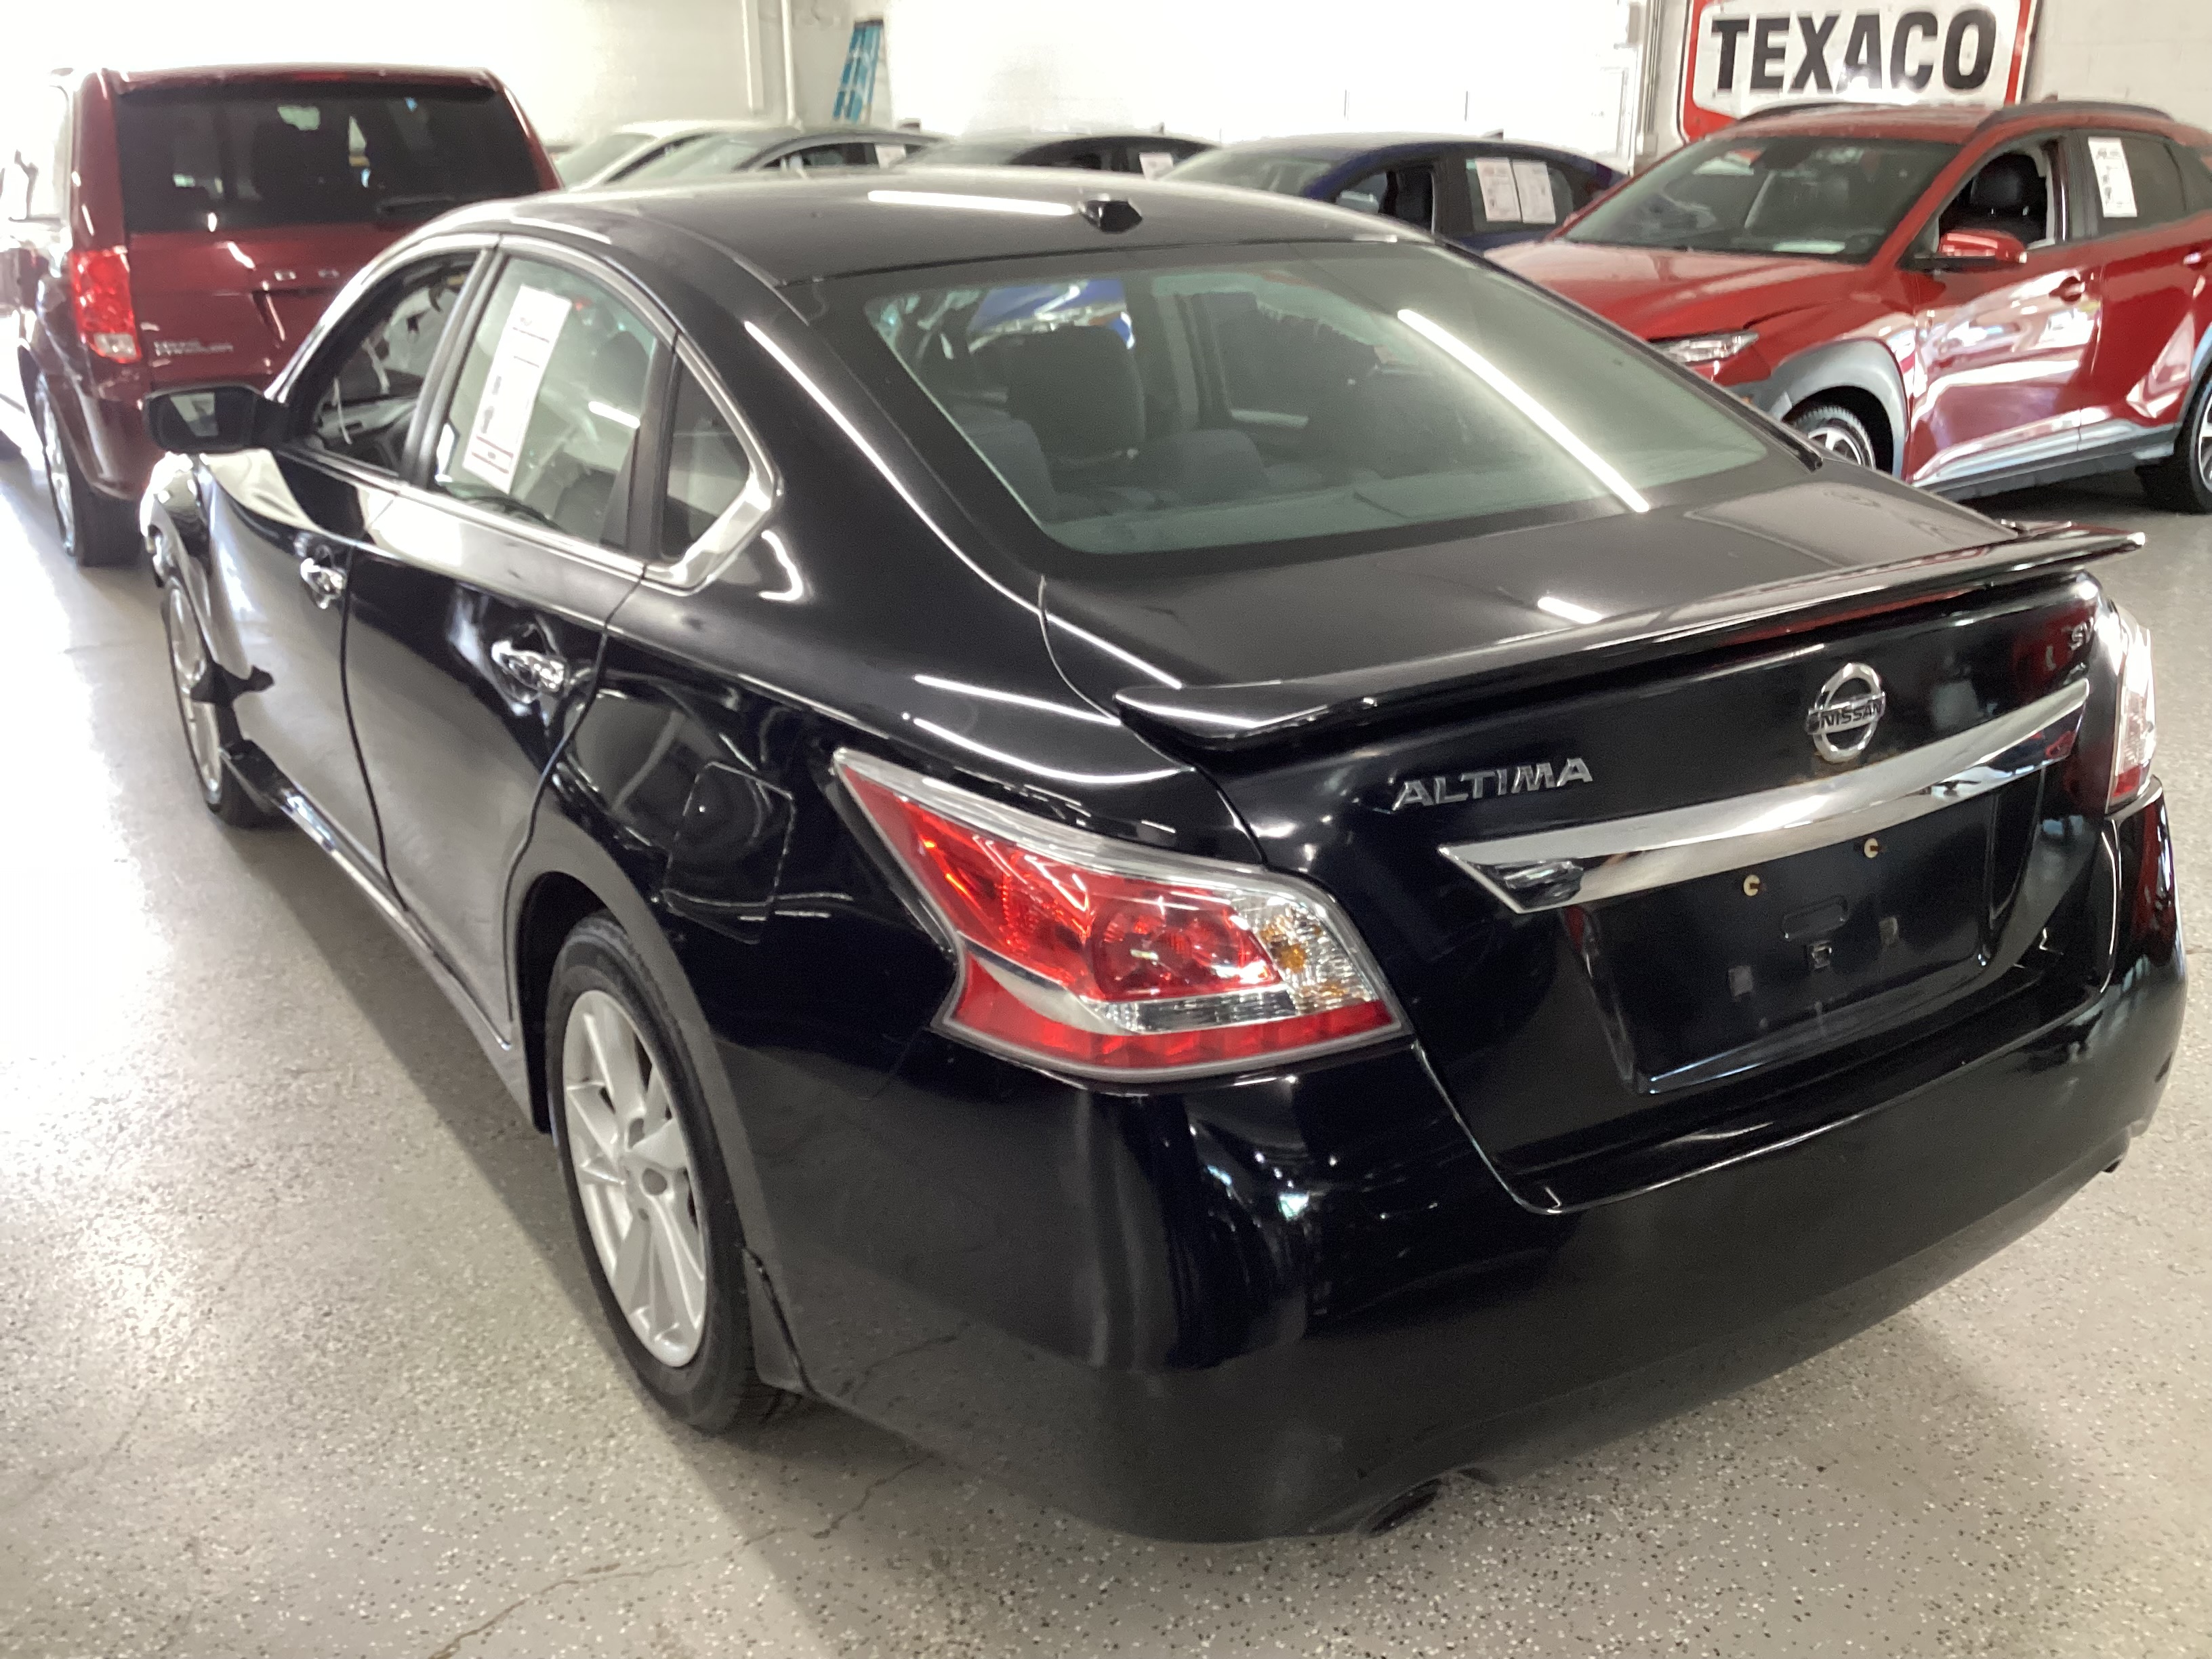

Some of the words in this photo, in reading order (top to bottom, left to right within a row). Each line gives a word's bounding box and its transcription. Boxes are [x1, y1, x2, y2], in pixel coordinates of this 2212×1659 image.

[1711, 8, 1997, 92] TEXACO
[1820, 700, 1883, 728] NISSAN
[1391, 757, 1593, 811] ALTIMA
